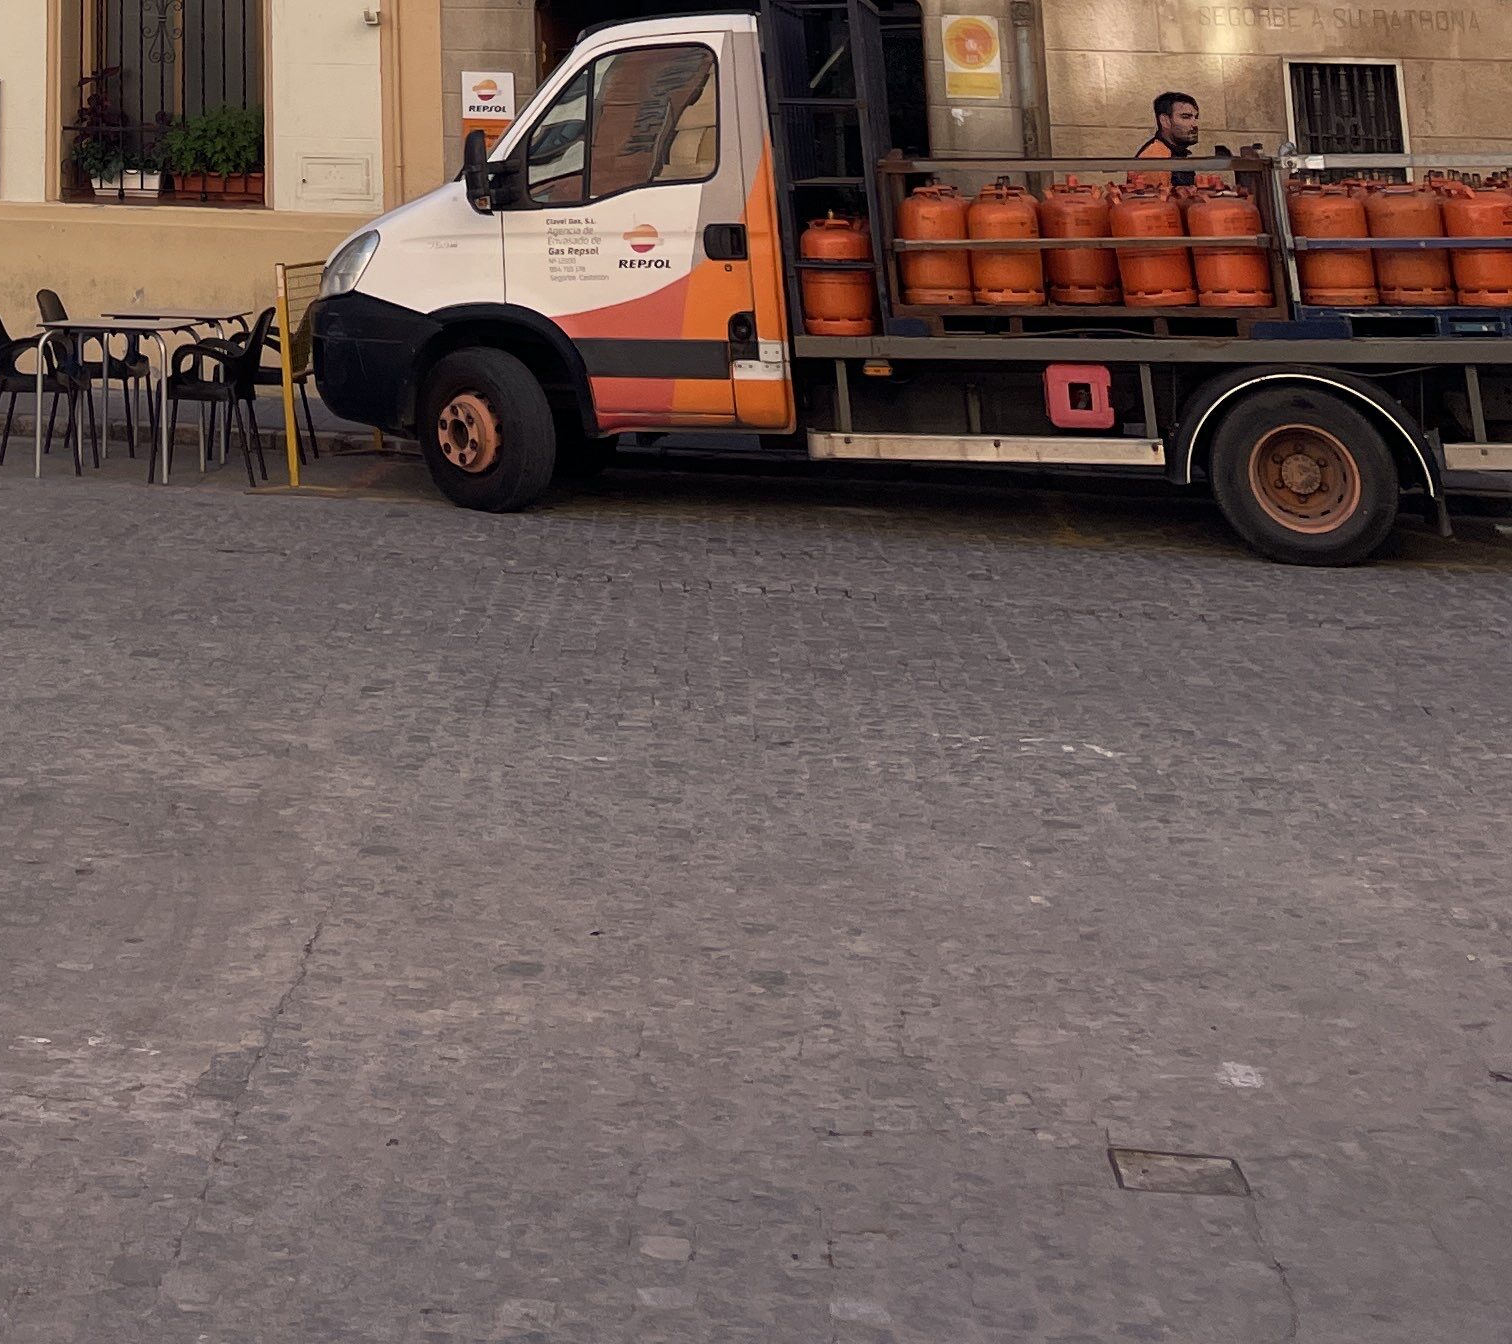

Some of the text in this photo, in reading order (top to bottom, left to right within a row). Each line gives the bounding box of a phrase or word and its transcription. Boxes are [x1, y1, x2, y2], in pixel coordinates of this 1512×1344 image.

[1198, 6, 1481, 32] SEGORBE A SU PATRONA
[468, 105, 507, 113] REPSOL
[548, 247, 600, 257] Gas Repsol
[618, 259, 671, 269] REPSOL
